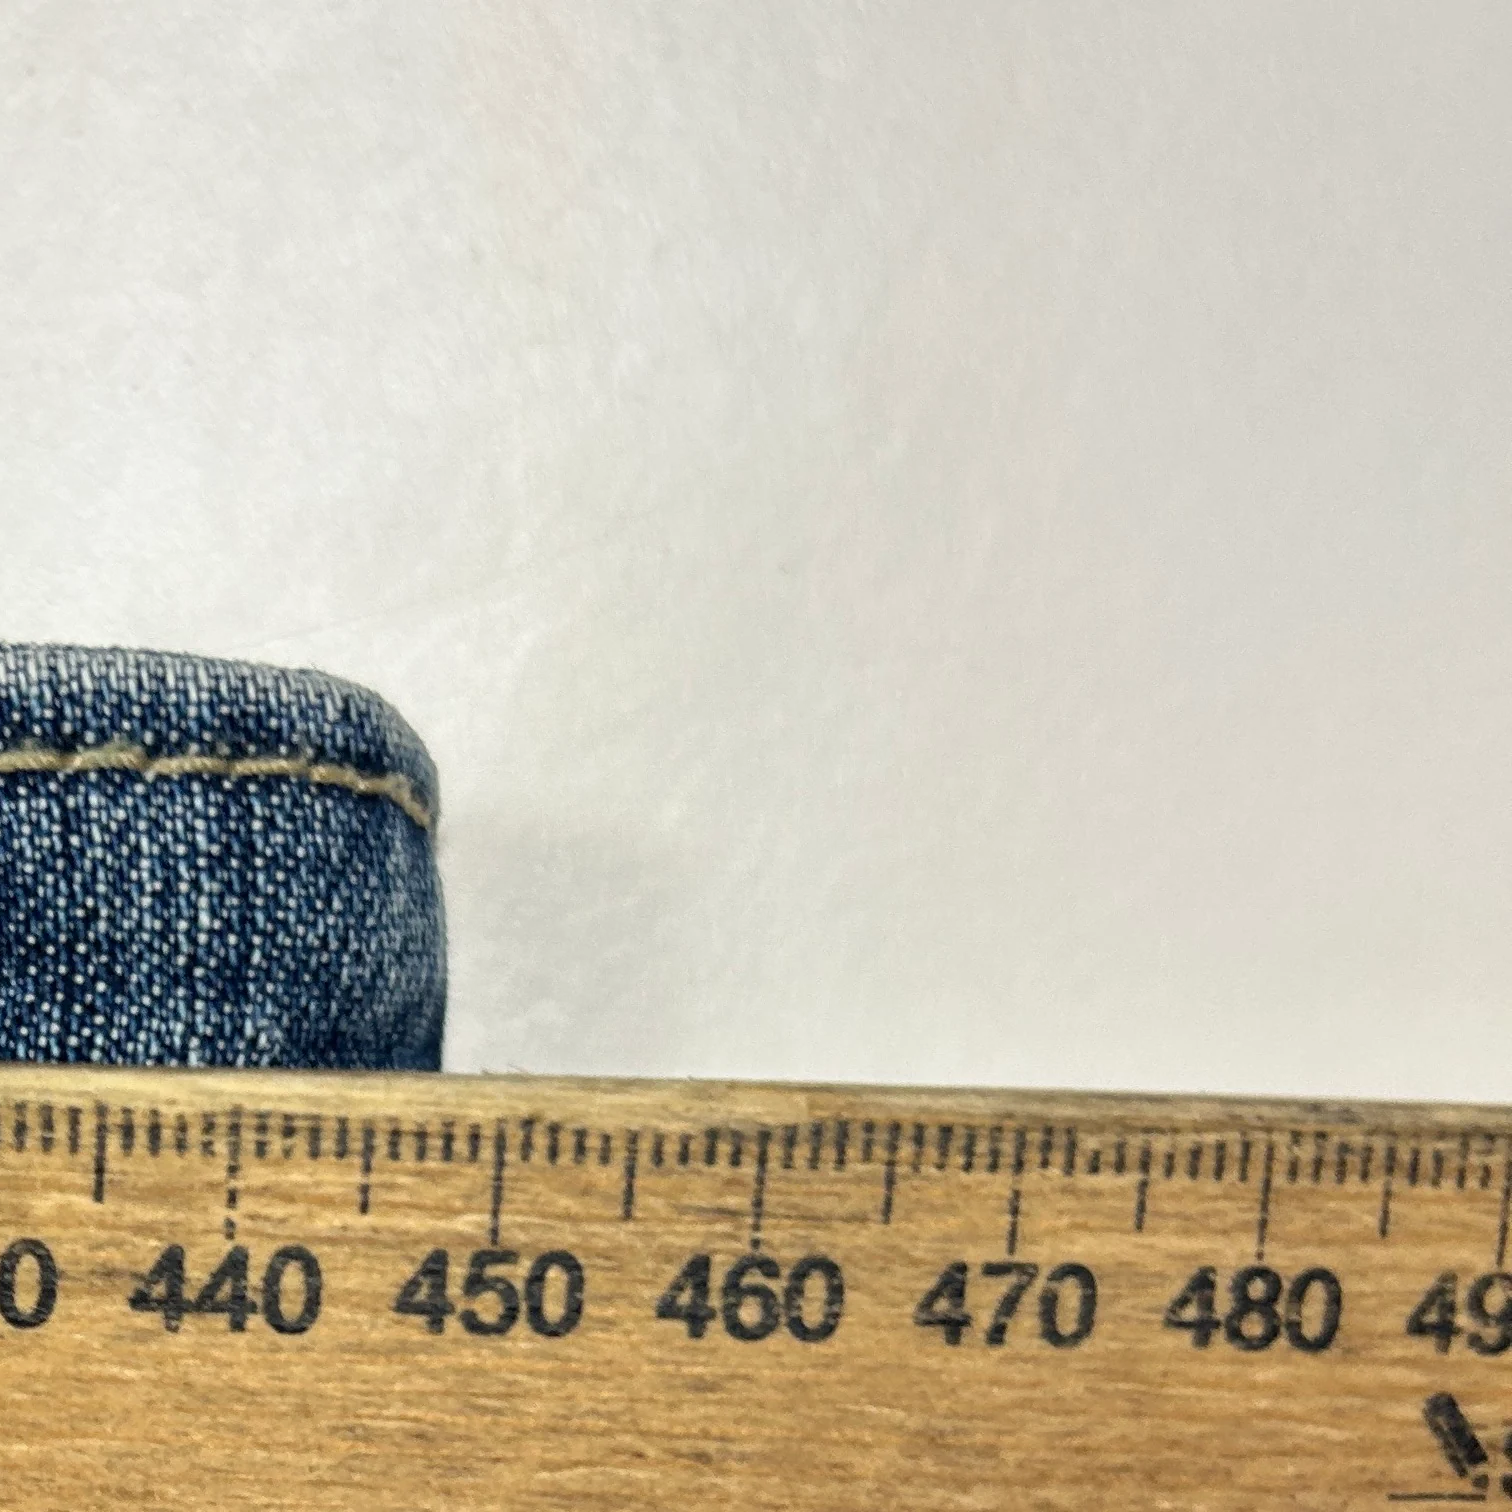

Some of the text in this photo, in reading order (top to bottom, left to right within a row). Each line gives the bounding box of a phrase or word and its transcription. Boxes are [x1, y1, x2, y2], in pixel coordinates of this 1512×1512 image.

[127, 1244, 323, 1335] 440
[392, 1248, 586, 1338] 450
[655, 1254, 846, 1343] 460
[916, 1261, 1098, 1348] 470
[1164, 1265, 1343, 1354] 480
